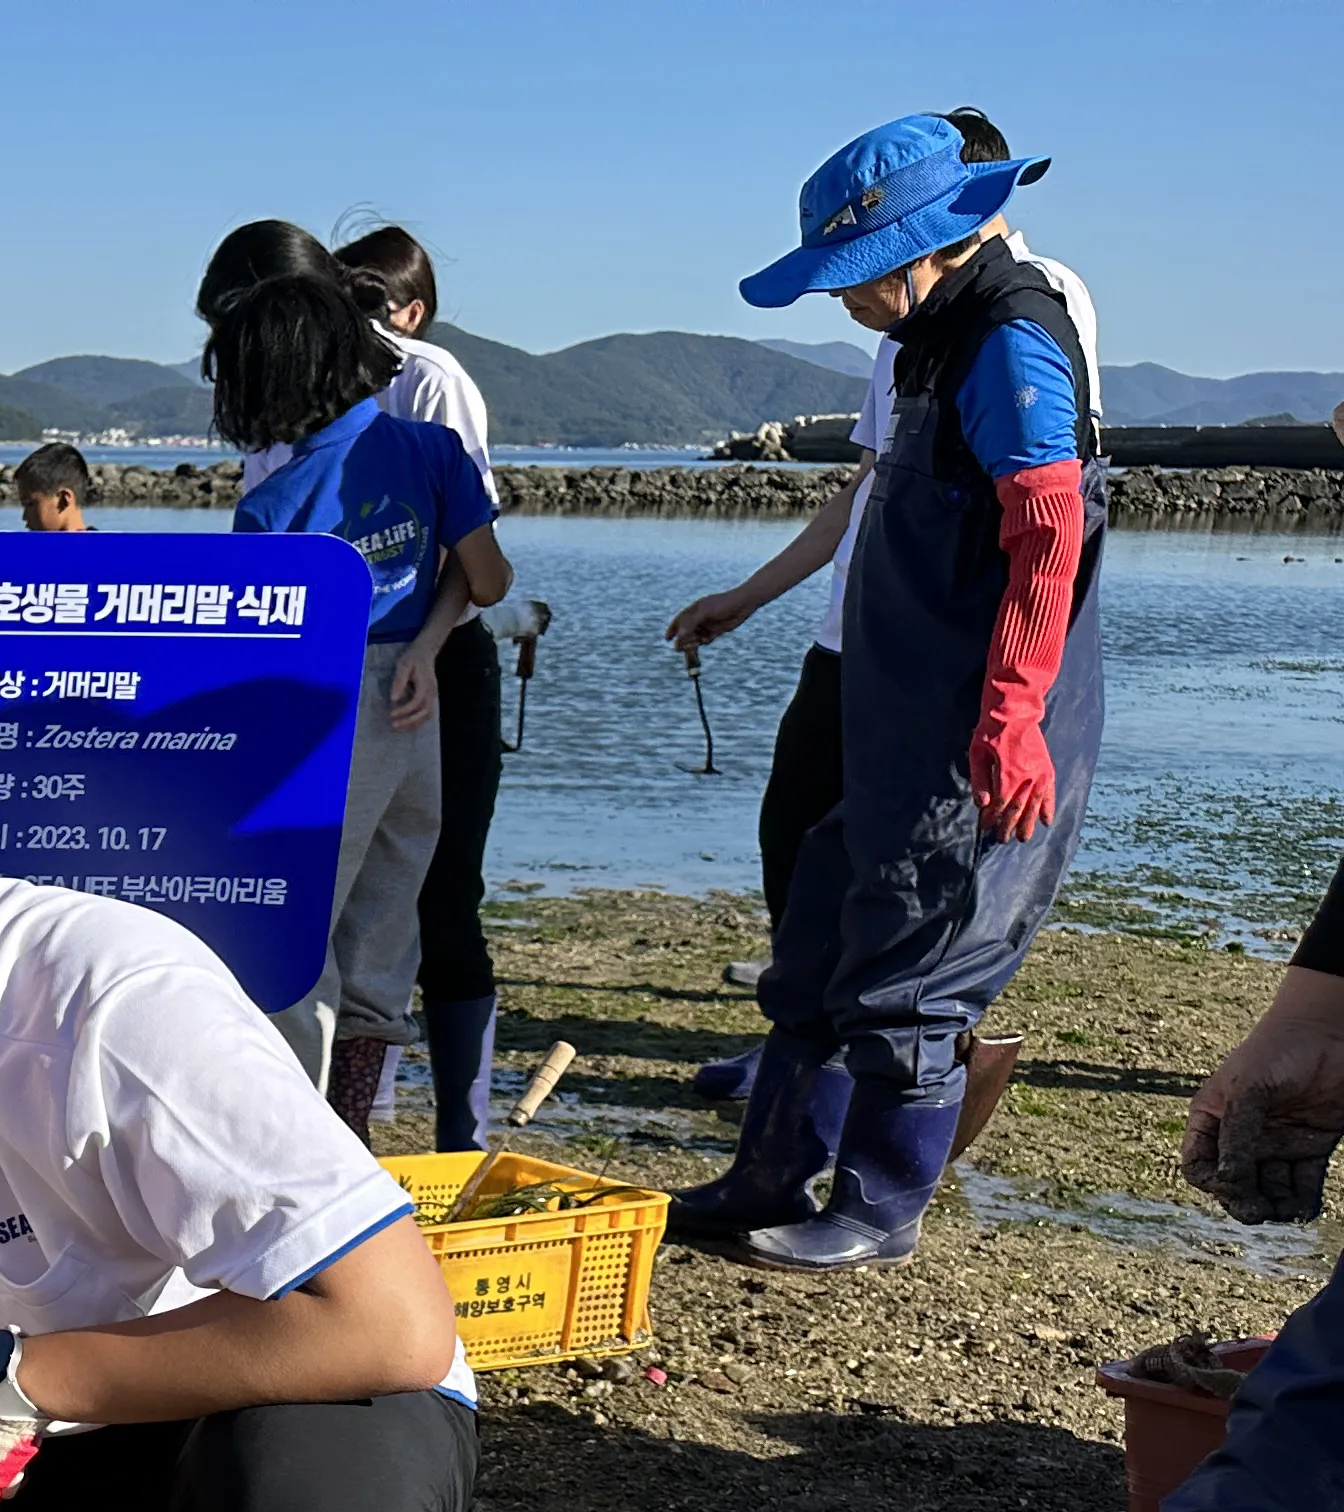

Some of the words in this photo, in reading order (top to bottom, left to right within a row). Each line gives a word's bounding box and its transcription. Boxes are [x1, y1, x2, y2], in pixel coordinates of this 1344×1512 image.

[94, 583, 233, 625] 거머리말
[236, 585, 307, 626] 식재
[42, 671, 142, 701] 거머리말
[34, 725, 140, 749] Zostera
[141, 726, 239, 751] marina
[31, 773, 86, 802] 30주
[26, 825, 91, 850] 2023.
[97, 826, 131, 850] 10.
[137, 827, 168, 851] 17
[120, 875, 289, 905] 부산아쿠아리움
[454, 1291, 546, 1319] 해양보호구역
